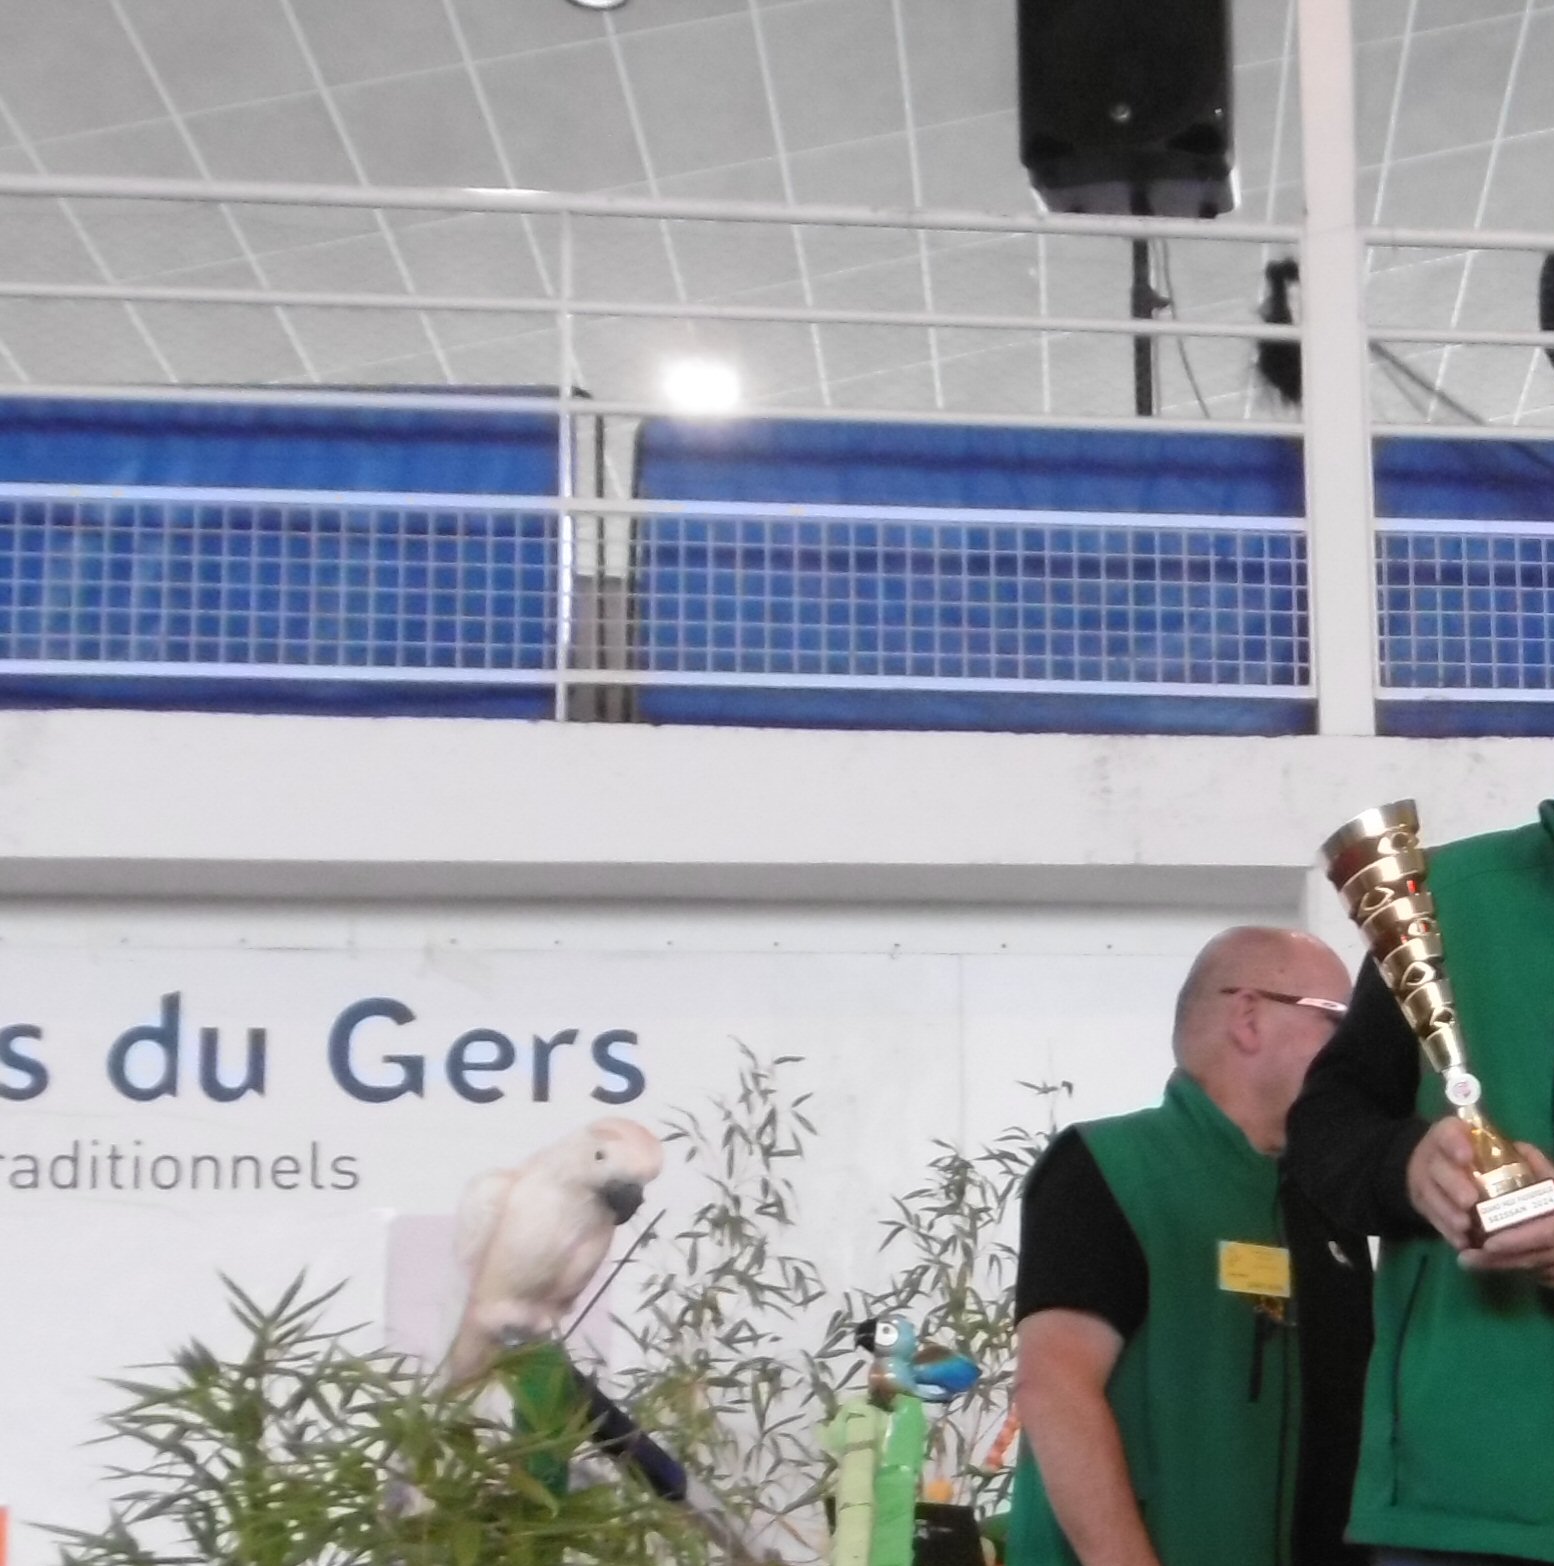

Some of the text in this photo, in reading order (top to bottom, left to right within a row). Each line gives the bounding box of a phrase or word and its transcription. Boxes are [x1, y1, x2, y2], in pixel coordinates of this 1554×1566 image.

[107, 991, 267, 1102] du
[327, 996, 646, 1103] Gers
[0, 1139, 360, 1190] aditionnels
